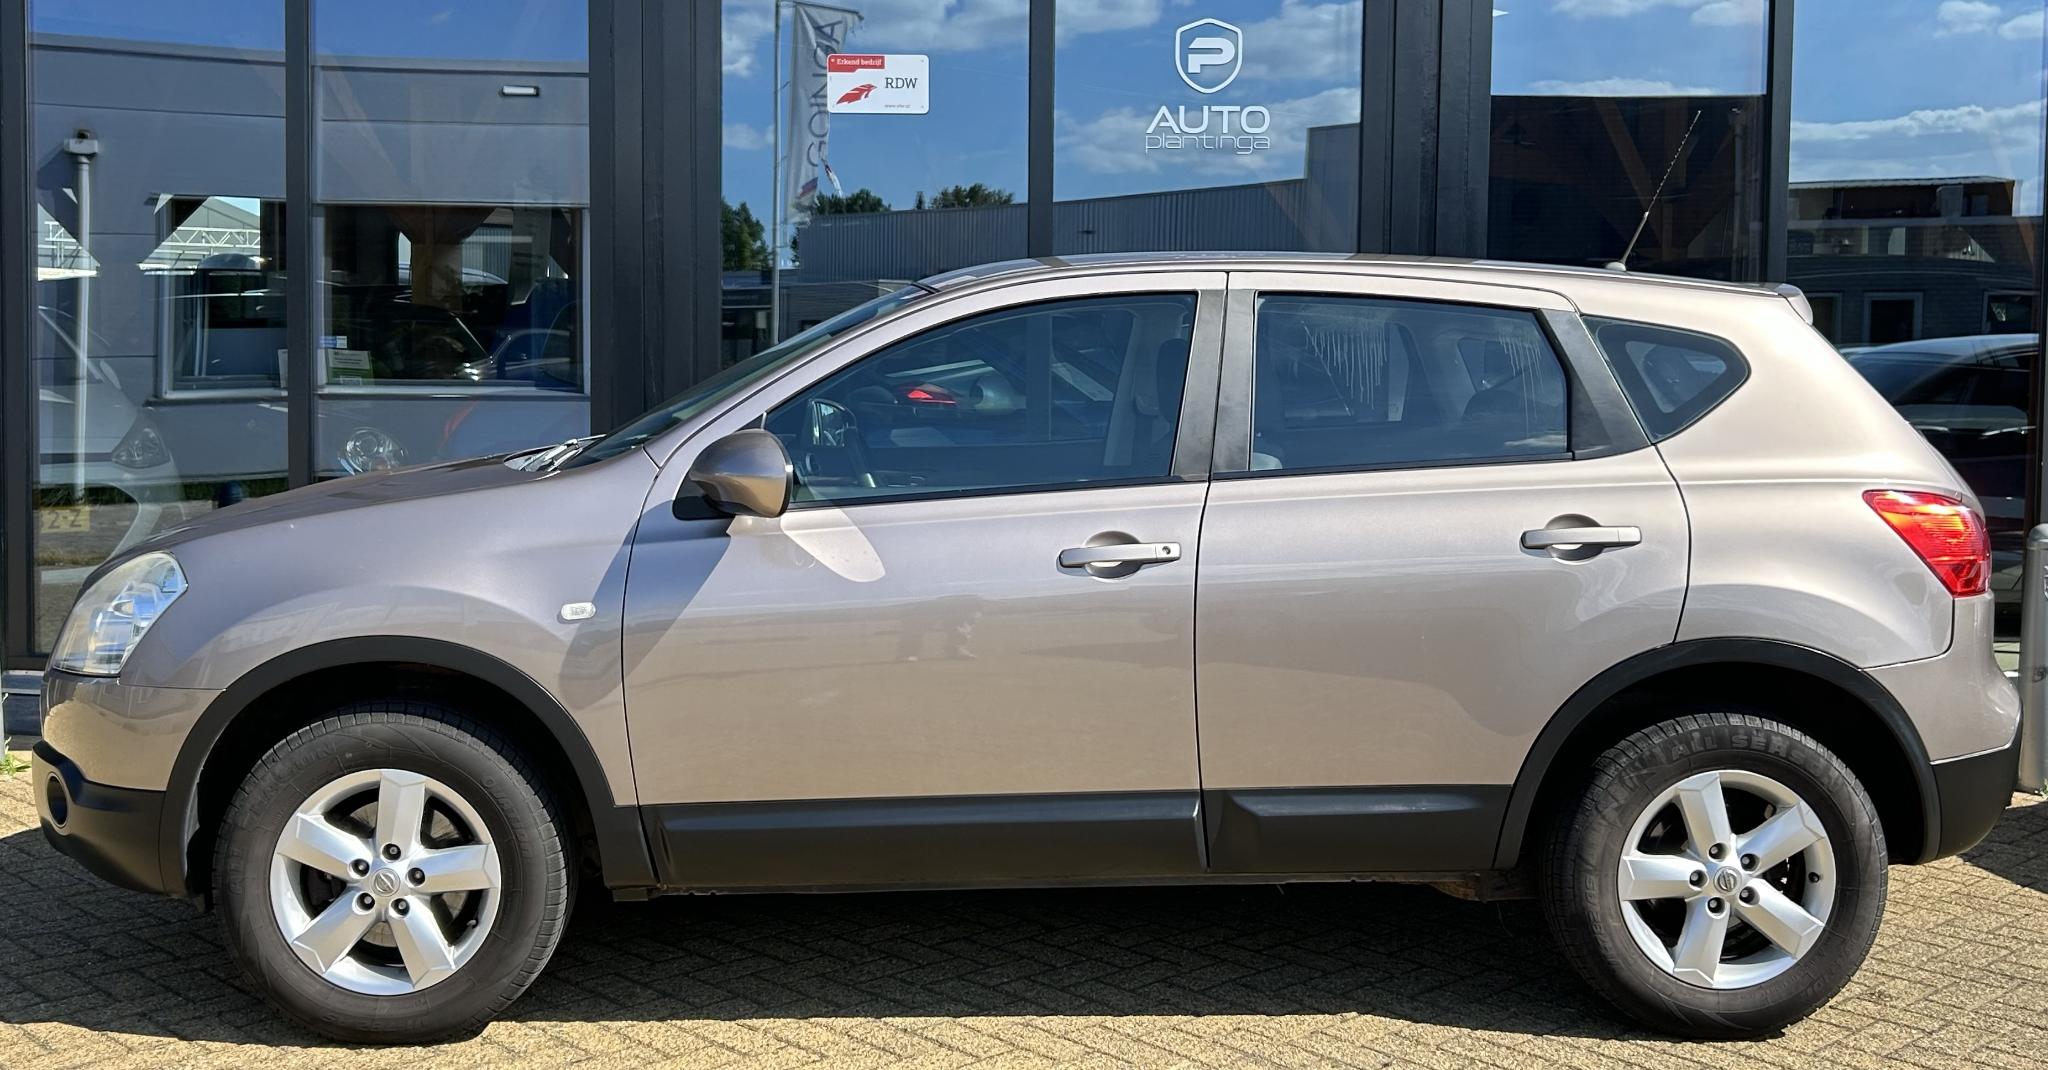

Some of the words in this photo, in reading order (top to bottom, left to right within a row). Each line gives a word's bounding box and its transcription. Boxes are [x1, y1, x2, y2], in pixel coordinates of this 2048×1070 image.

[836, 58, 860, 66] Erkend
[860, 58, 882, 66] bedrijf
[884, 77, 919, 89] RDW
[1145, 105, 1271, 134] AUTO
[1145, 132, 1271, 155] plantinga
